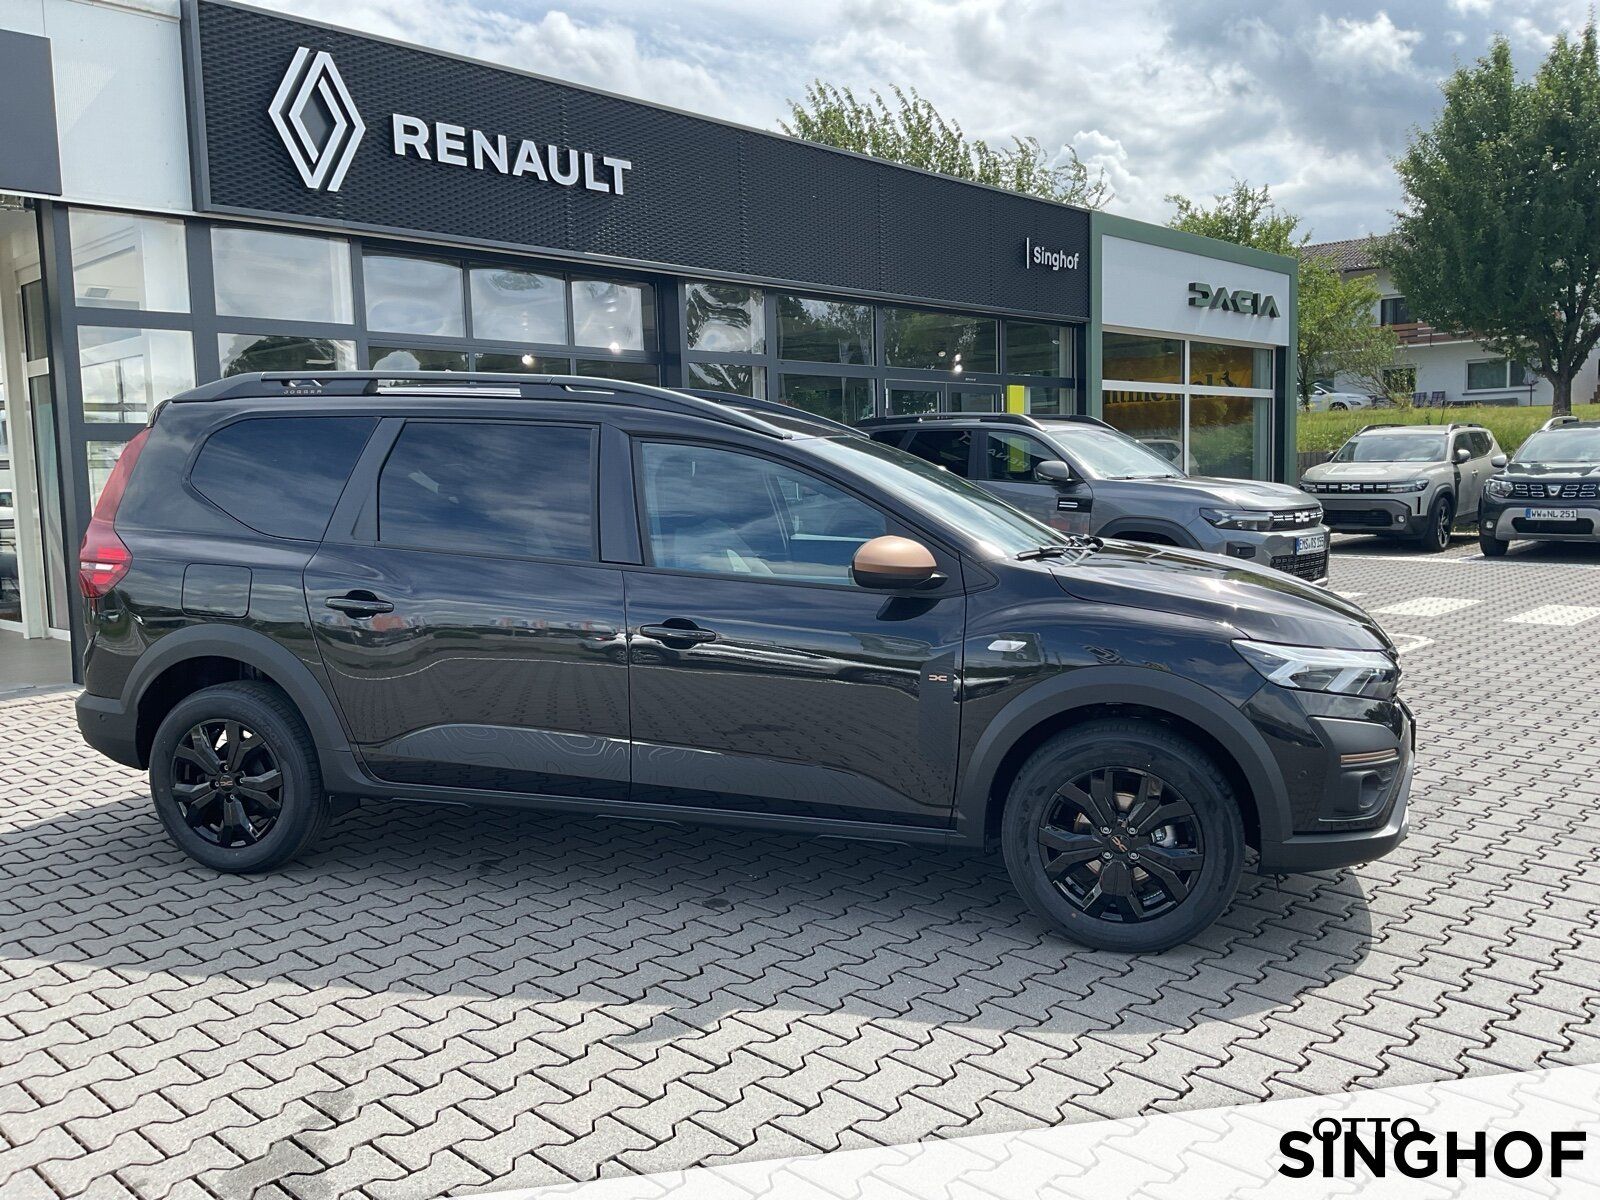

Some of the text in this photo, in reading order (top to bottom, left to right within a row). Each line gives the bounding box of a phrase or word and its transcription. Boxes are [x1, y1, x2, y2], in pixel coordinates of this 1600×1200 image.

[392, 112, 632, 196] RENAULT
[1033, 246, 1080, 271] Singhof
[1188, 281, 1281, 319] DACIA
[1559, 510, 1575, 518] 251
